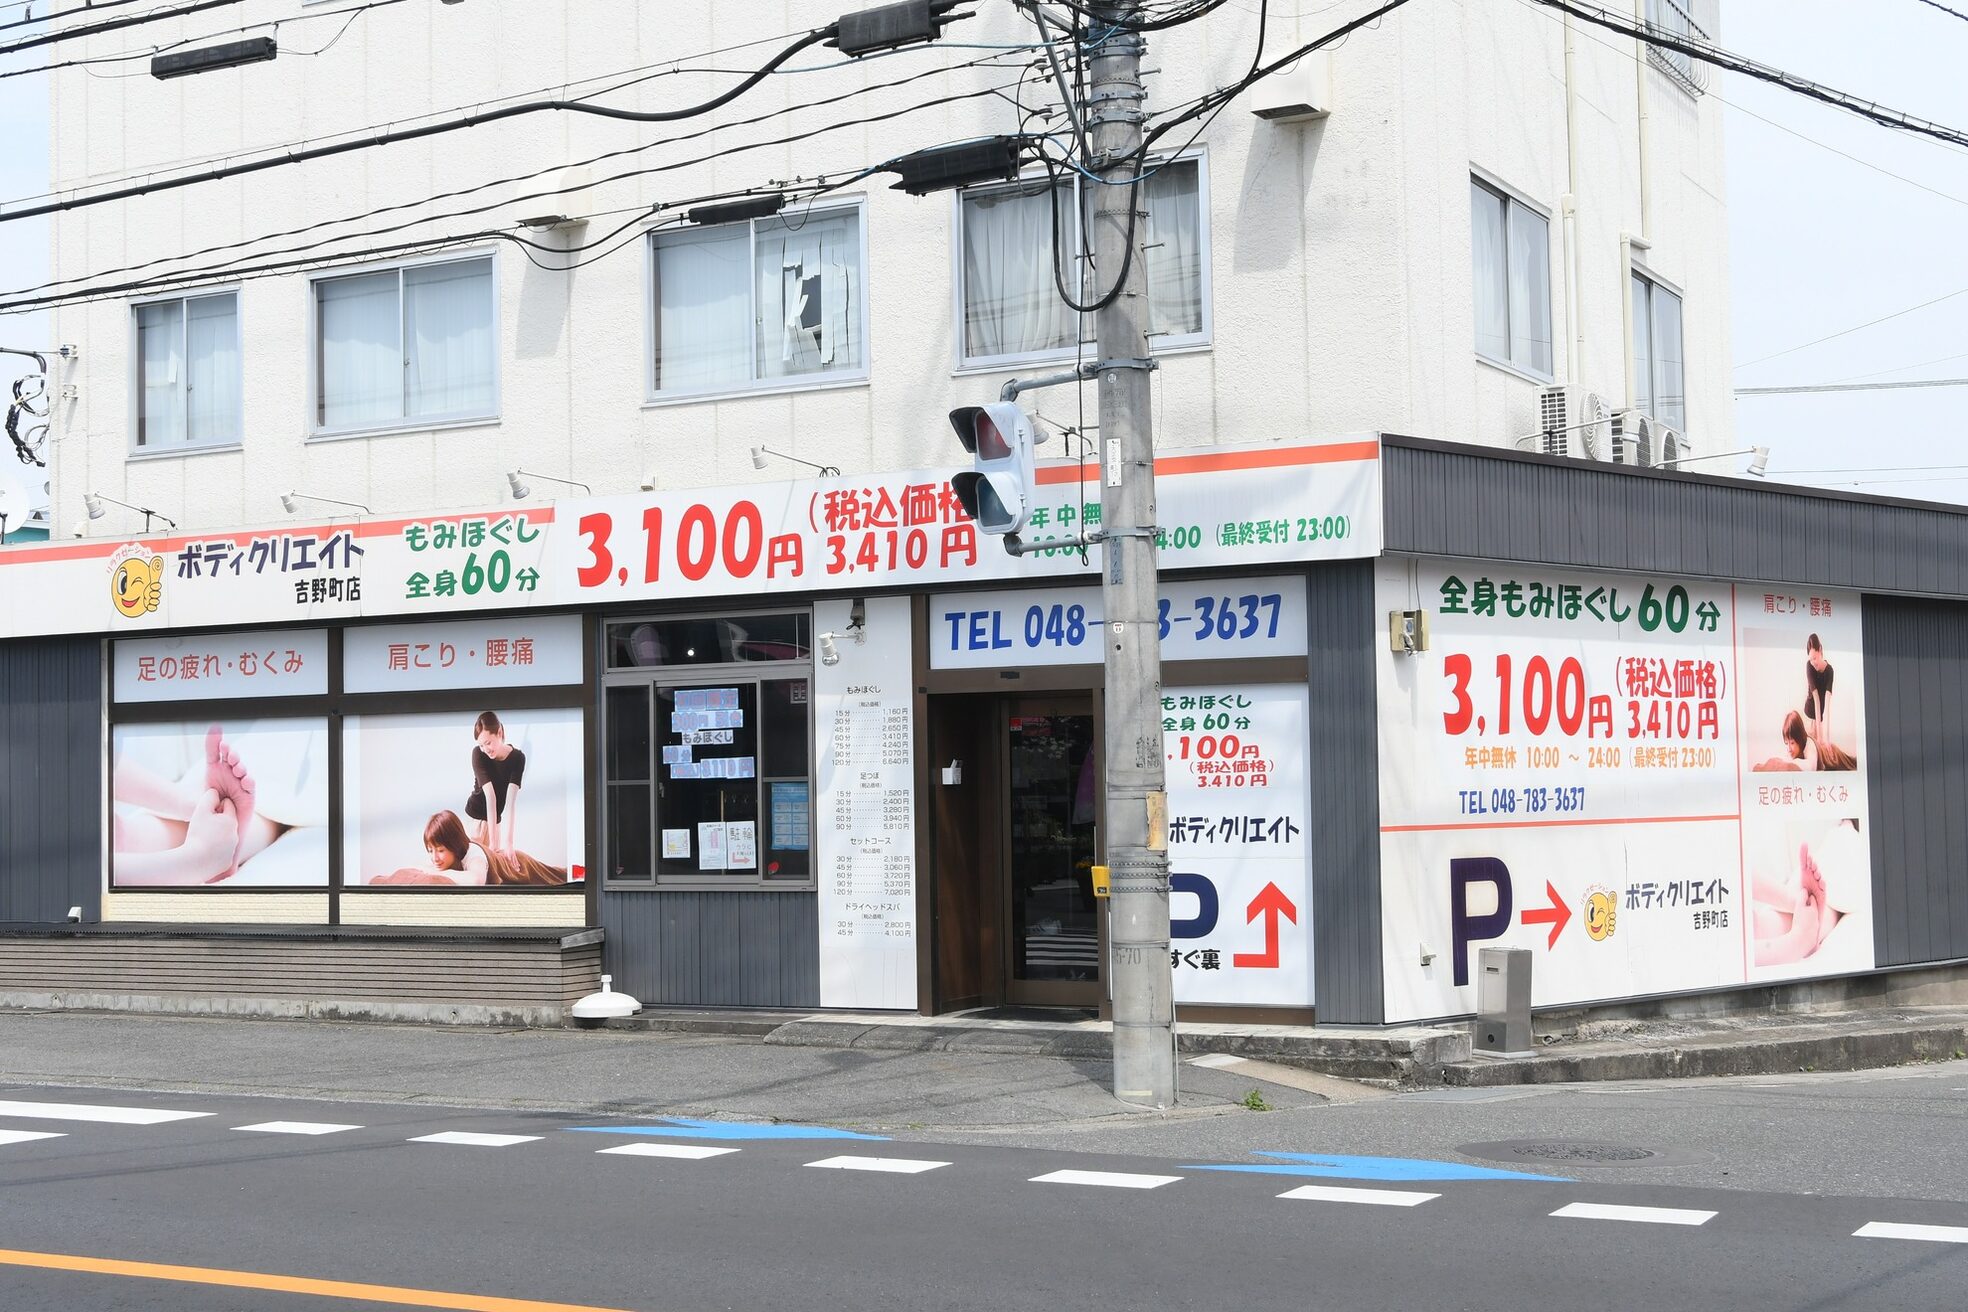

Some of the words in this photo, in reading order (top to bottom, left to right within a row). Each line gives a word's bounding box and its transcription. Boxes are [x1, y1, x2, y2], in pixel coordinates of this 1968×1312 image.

[809, 482, 974, 534] (税込価格
[1030, 502, 1102, 530] 年中無
[404, 516, 541, 552] もみほぐし
[577, 500, 804, 588] 3,100円
[825, 523, 978, 575] 3,410円
[1156, 525, 1201, 551] 4:00
[1216, 519, 1290, 547] (最終受付
[1296, 515, 1351, 542] 23:00)
[178, 533, 365, 578] ボディクリエイト
[295, 576, 361, 604] 吉野町店
[404, 552, 541, 600] 全身60分
[945, 611, 1012, 650] TEL
[1024, 593, 1282, 648] 048-3-3637
[1764, 593, 1832, 618] 肩こり・腰痛
[136, 646, 304, 683] 足の疲れ・むくみ
[388, 637, 534, 671] 肩こり・腰痛
[847, 686, 881, 695] もみほぐし
[1616, 656, 1727, 701] (税込価格)
[1160, 694, 1252, 712] もみほぐし
[1443, 653, 1613, 739] 3,100円
[683, 731, 733, 744] もみほぐし
[1161, 712, 1252, 732] 全身60分
[1628, 701, 1719, 741] 3,410円
[1168, 734, 1260, 761] ,100円
[1465, 746, 1517, 769] 年中無休
[1527, 746, 1560, 769] 10:00
[1588, 746, 1621, 769] 24:00
[1682, 747, 1716, 769] 23:00)
[1459, 790, 1487, 814] TEL
[1491, 787, 1585, 813] 048-783-3637
[1758, 785, 1849, 807] 足の疲れ・むくみ
[1169, 815, 1300, 844] ボディクリエイト
[1626, 878, 1729, 911] ボディクリエイト
[1450, 856, 1513, 987] P
[1693, 910, 1728, 930] 吉野町店
